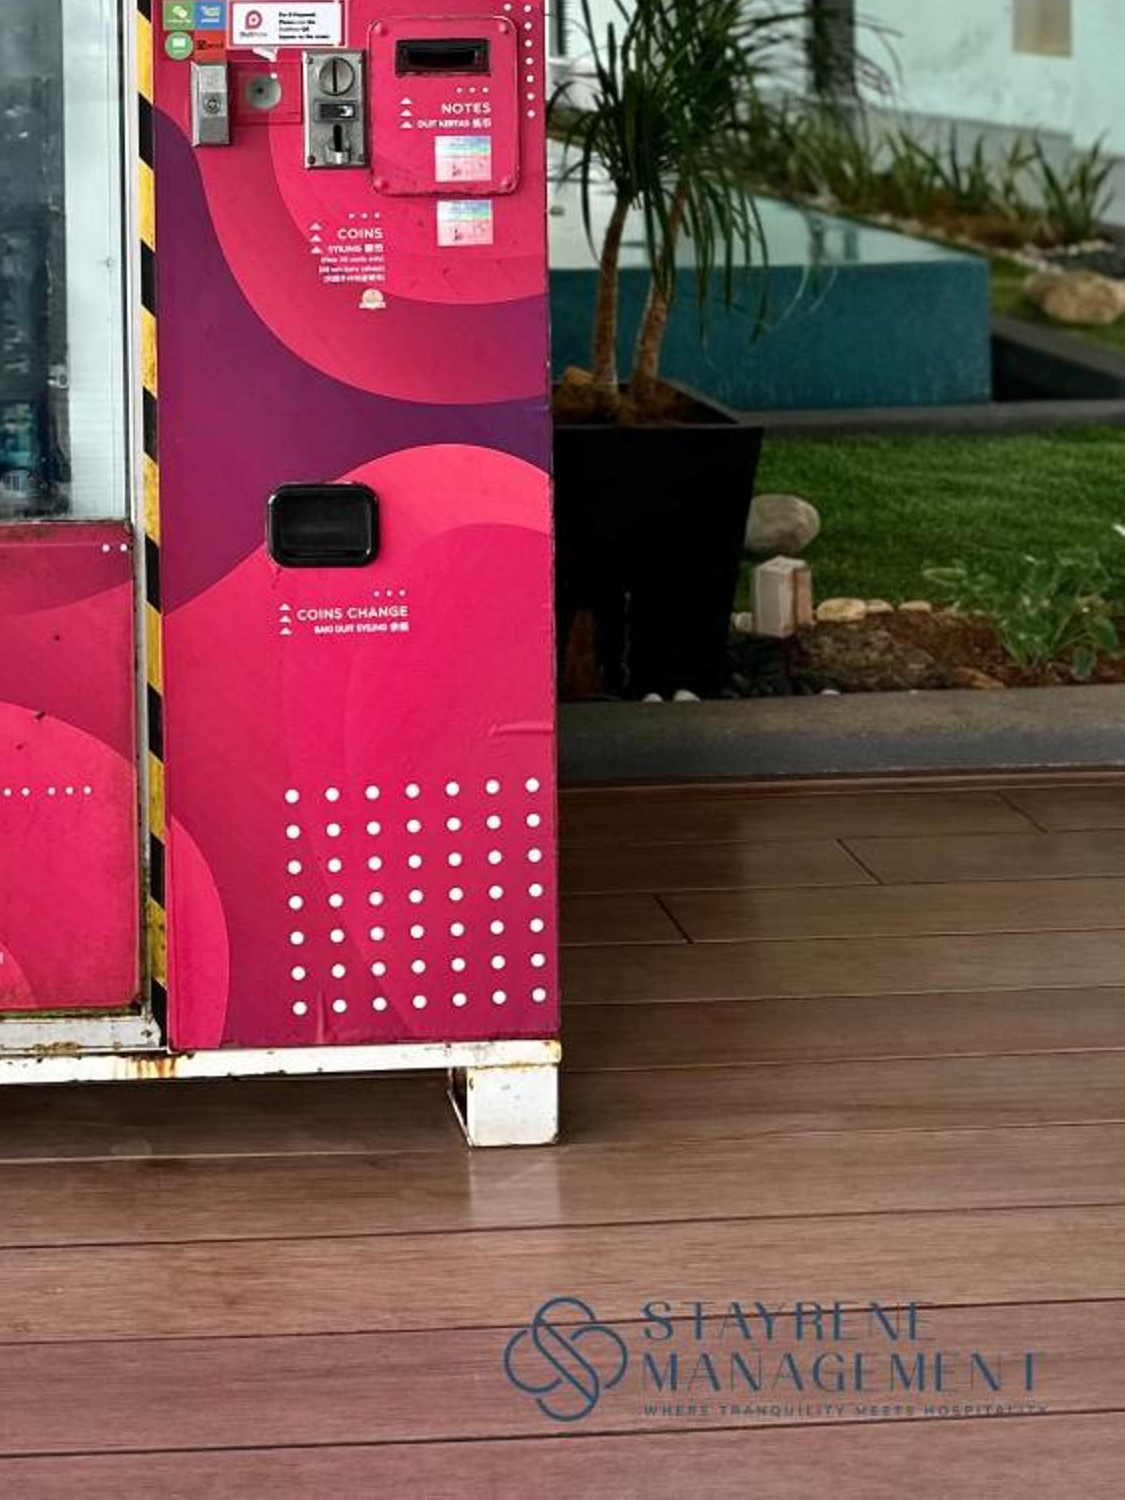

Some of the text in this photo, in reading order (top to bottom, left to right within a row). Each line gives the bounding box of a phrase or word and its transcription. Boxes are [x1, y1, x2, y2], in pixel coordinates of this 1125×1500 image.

[441, 102, 492, 115] NOTES
[337, 227, 384, 240] COINS
[296, 605, 409, 621] COINS CHANGE
